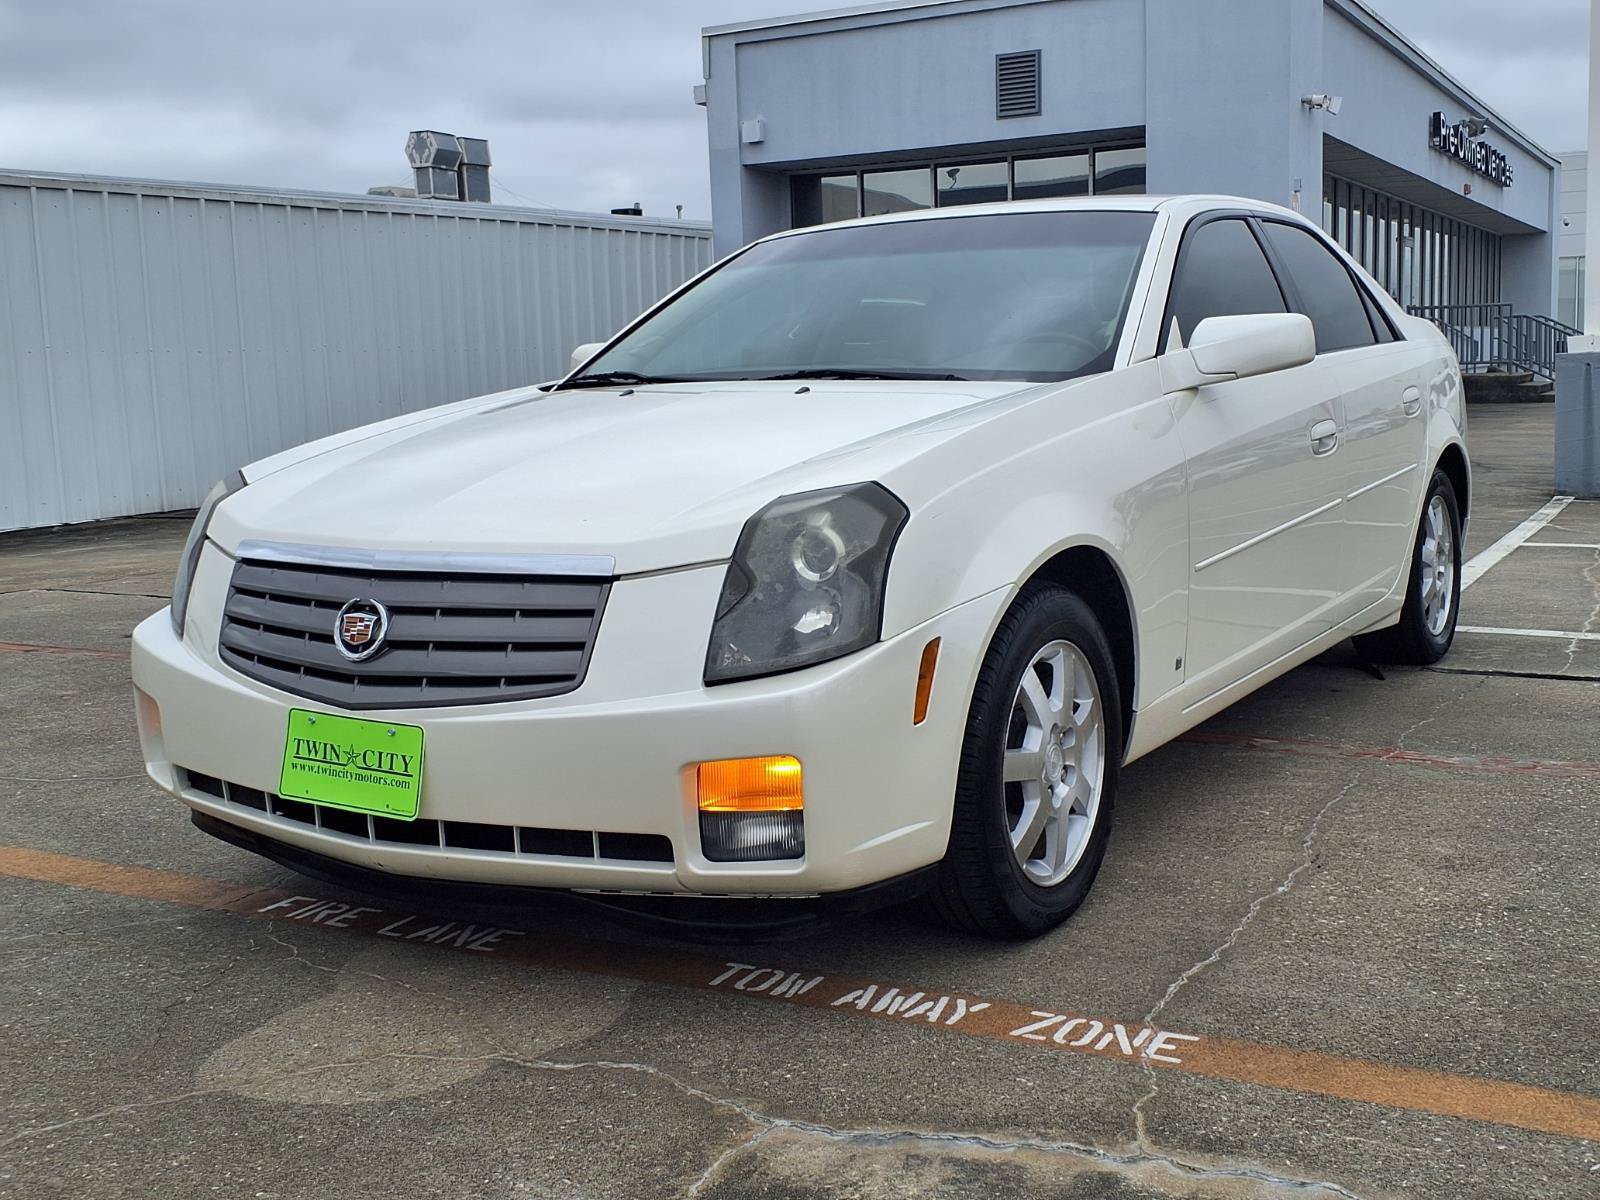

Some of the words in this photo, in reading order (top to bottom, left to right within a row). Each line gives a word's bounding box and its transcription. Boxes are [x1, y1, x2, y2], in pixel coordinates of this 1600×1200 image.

[291, 762, 411, 789] www.twincitymotors.com
[293, 738, 341, 762] TWIN
[362, 750, 414, 773] CITY
[257, 895, 383, 928] FIRE
[377, 915, 526, 952] LANE
[708, 962, 824, 998] TOW
[830, 984, 992, 1025] AWAY
[1008, 1010, 1201, 1064] ZONE
